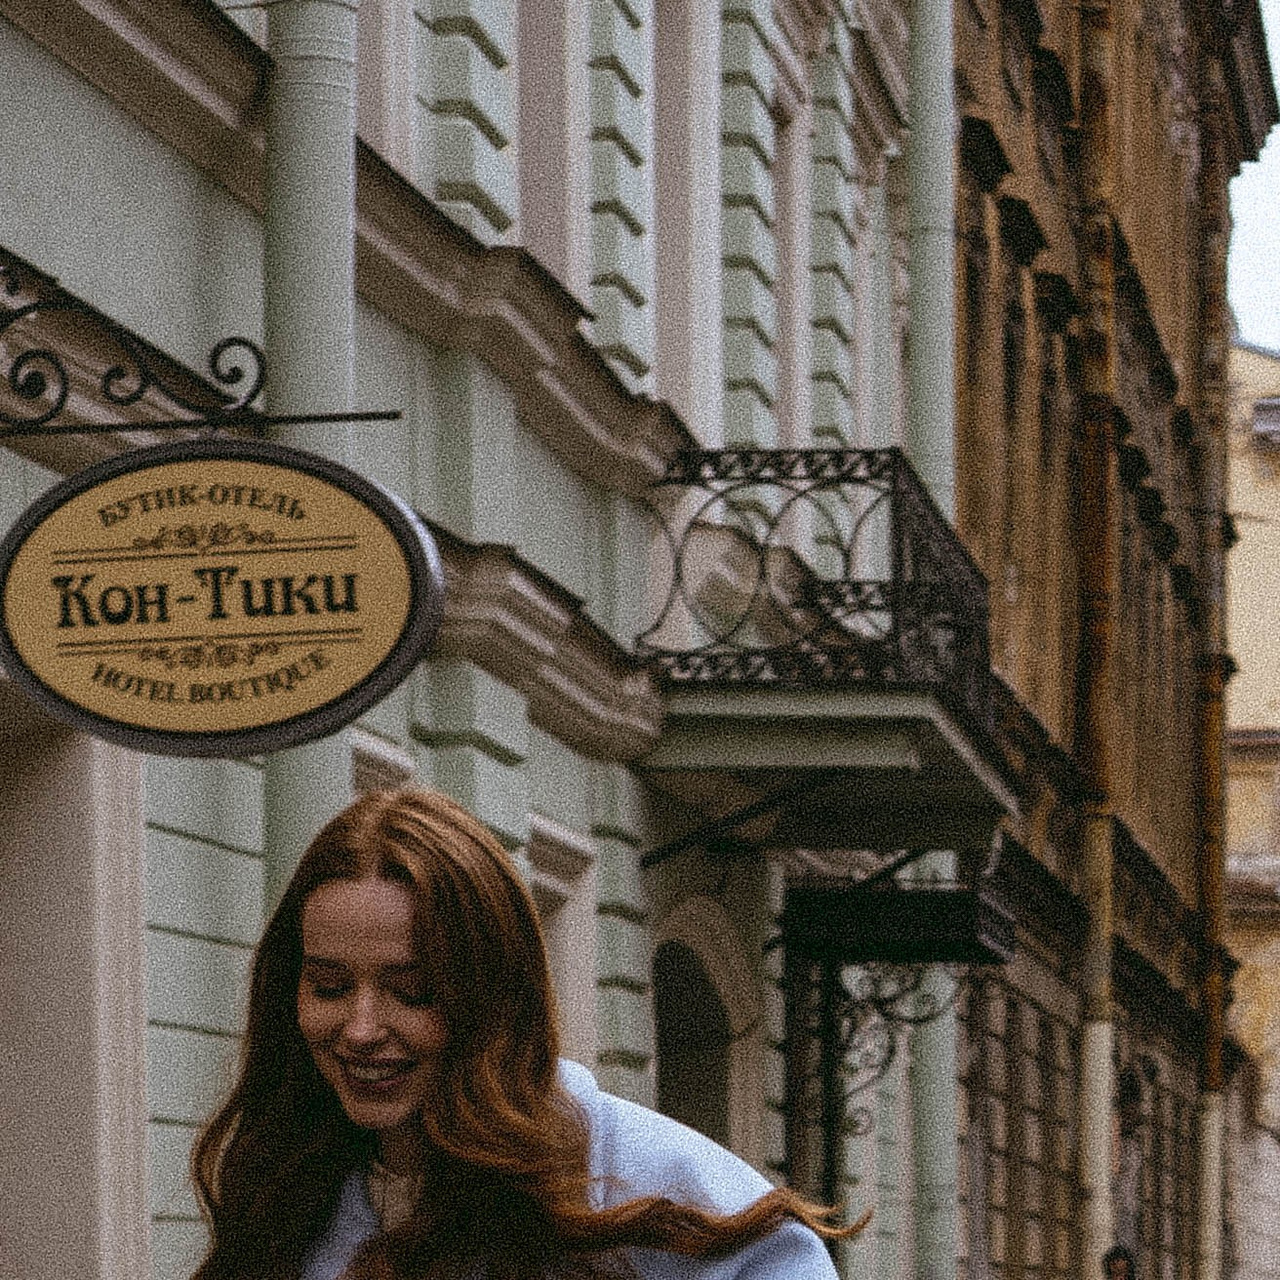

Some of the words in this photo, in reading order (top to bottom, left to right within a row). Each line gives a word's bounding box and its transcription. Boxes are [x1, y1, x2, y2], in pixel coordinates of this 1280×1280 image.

[97, 483, 306, 527] БУТИК-ОТЕЛЬ
[52, 565, 359, 629] Кон-Тики
[92, 661, 180, 702] HOTEL
[188, 649, 333, 703] BOUTIQUE
